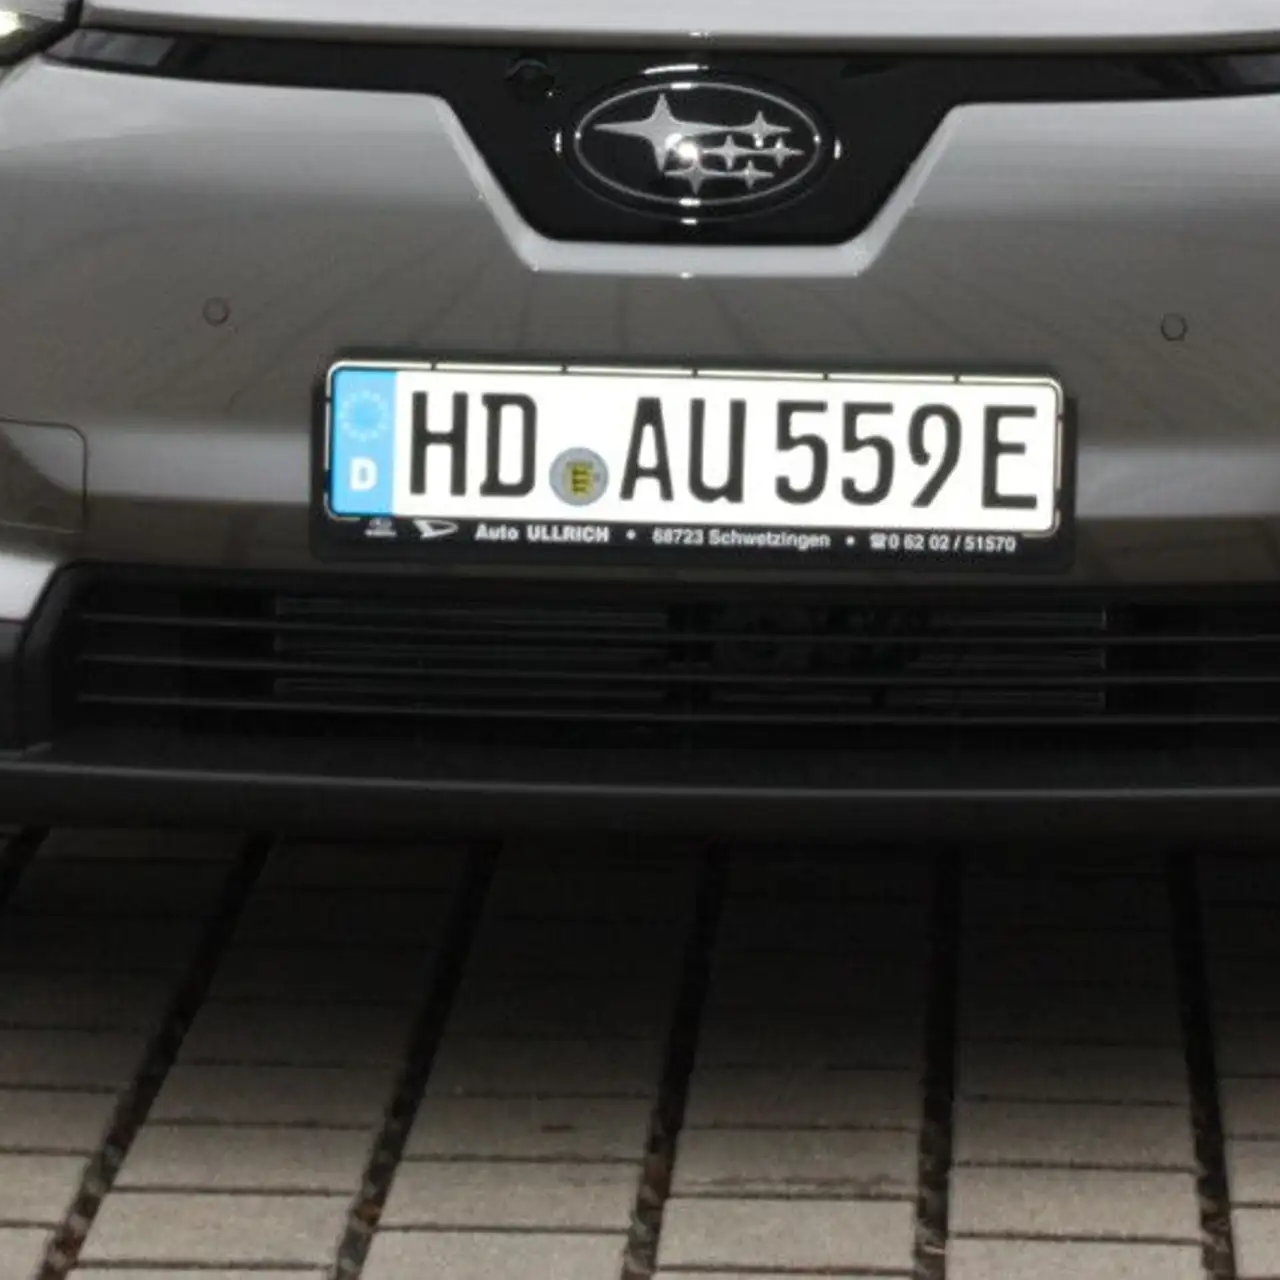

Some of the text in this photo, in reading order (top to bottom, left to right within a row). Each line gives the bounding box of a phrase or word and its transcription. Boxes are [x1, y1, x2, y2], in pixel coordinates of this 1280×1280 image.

[411, 391, 538, 497] HD
[350, 457, 378, 491] D
[474, 523, 519, 541] Auto
[527, 524, 609, 542] ULLRICH
[708, 529, 831, 552] Schwetzingen
[964, 535, 1017, 553] 51570
